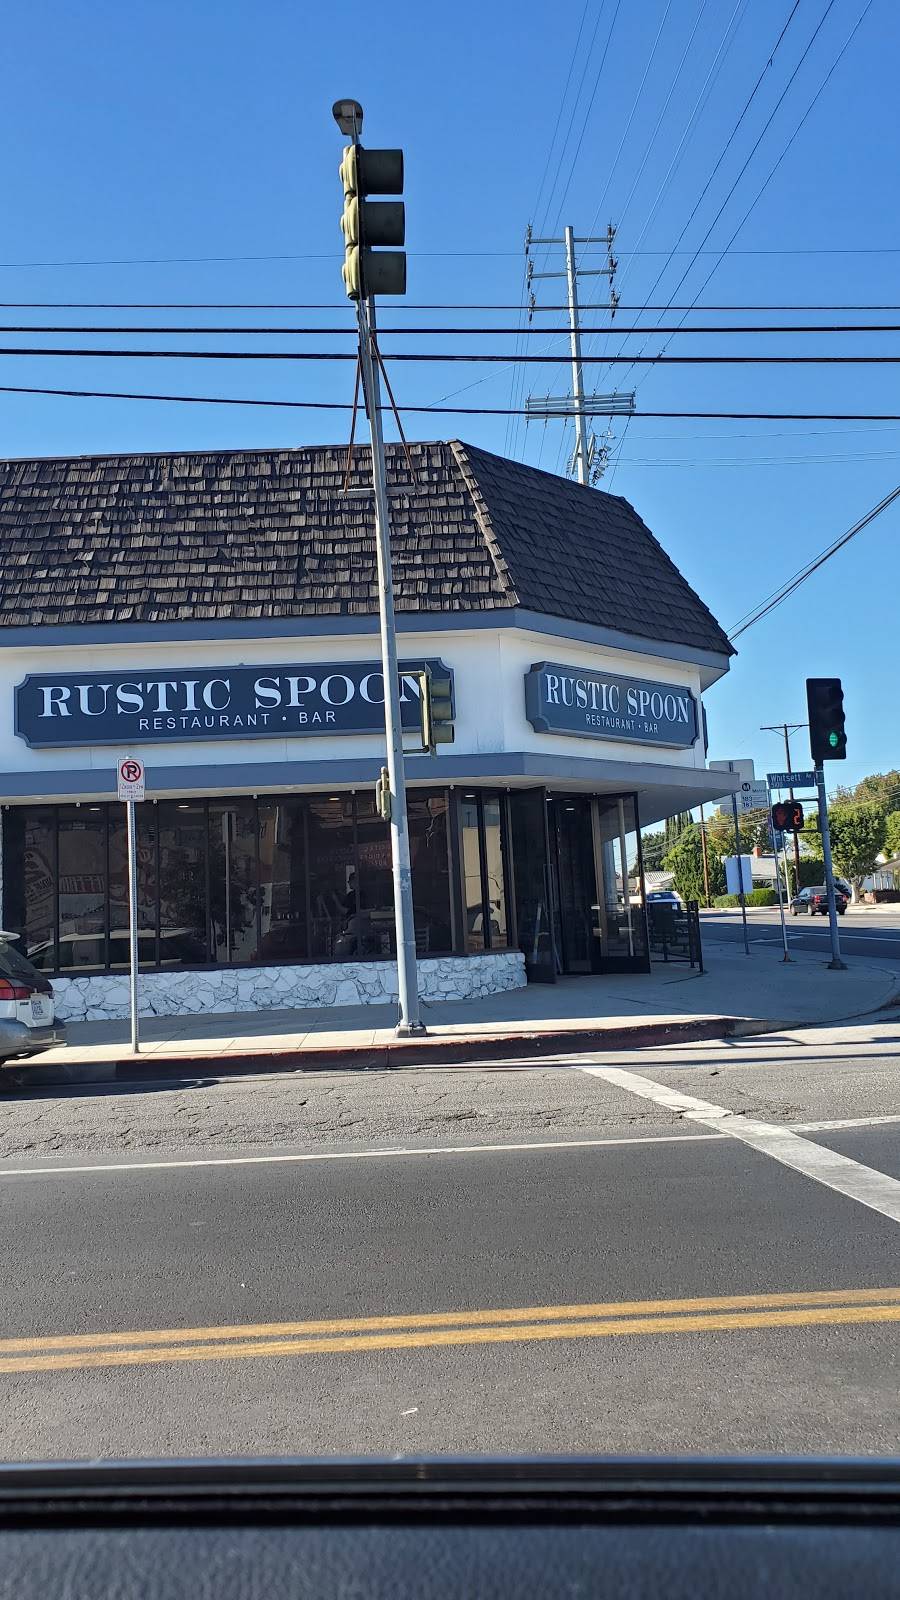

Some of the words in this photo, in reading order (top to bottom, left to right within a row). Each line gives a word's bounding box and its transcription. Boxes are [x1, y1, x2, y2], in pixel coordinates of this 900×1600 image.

[37, 679, 231, 718] RUSTIC
[254, 672, 421, 709] SPOON
[544, 674, 620, 713] RUSTIC
[627, 687, 689, 723] SPOON
[139, 713, 270, 730] RESTAURANT
[299, 711, 336, 724] BAR
[585, 714, 635, 731] RESTAURANT
[644, 723, 659, 734] BAR
[770, 774, 801, 783] Whitsett
